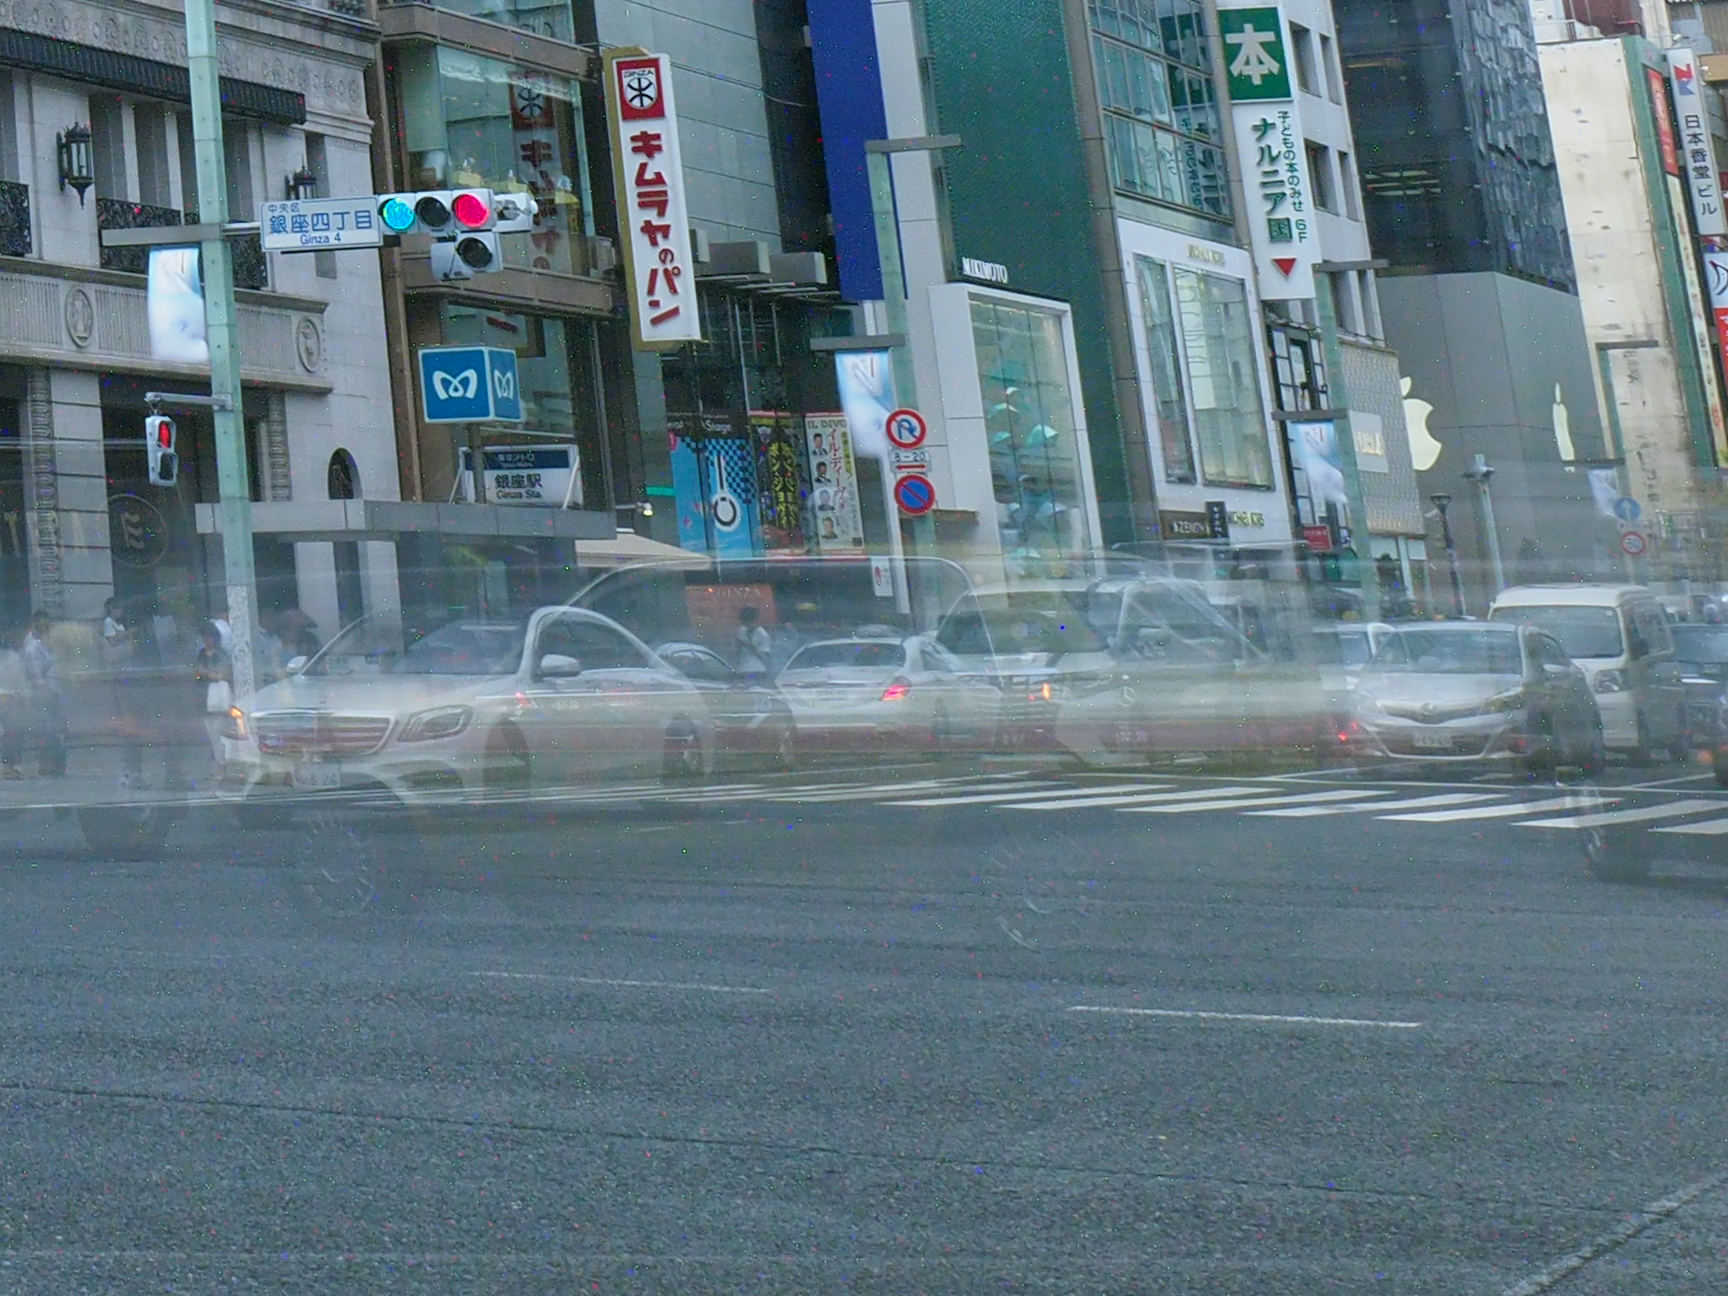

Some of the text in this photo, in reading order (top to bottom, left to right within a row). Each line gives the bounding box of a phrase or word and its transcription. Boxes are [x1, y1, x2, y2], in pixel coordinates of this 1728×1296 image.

[1224, 21, 1281, 87] 本
[1250, 117, 1294, 244] ナルニア国
[1277, 110, 1304, 213] 子どもの本のみせ
[1683, 114, 1719, 216] 日本香堂ビル
[269, 209, 373, 234] 銀座四丁目
[300, 233, 342, 245] Ginza 4
[629, 129, 682, 327] キムラヤのパン
[495, 473, 544, 489] 銀座駅
